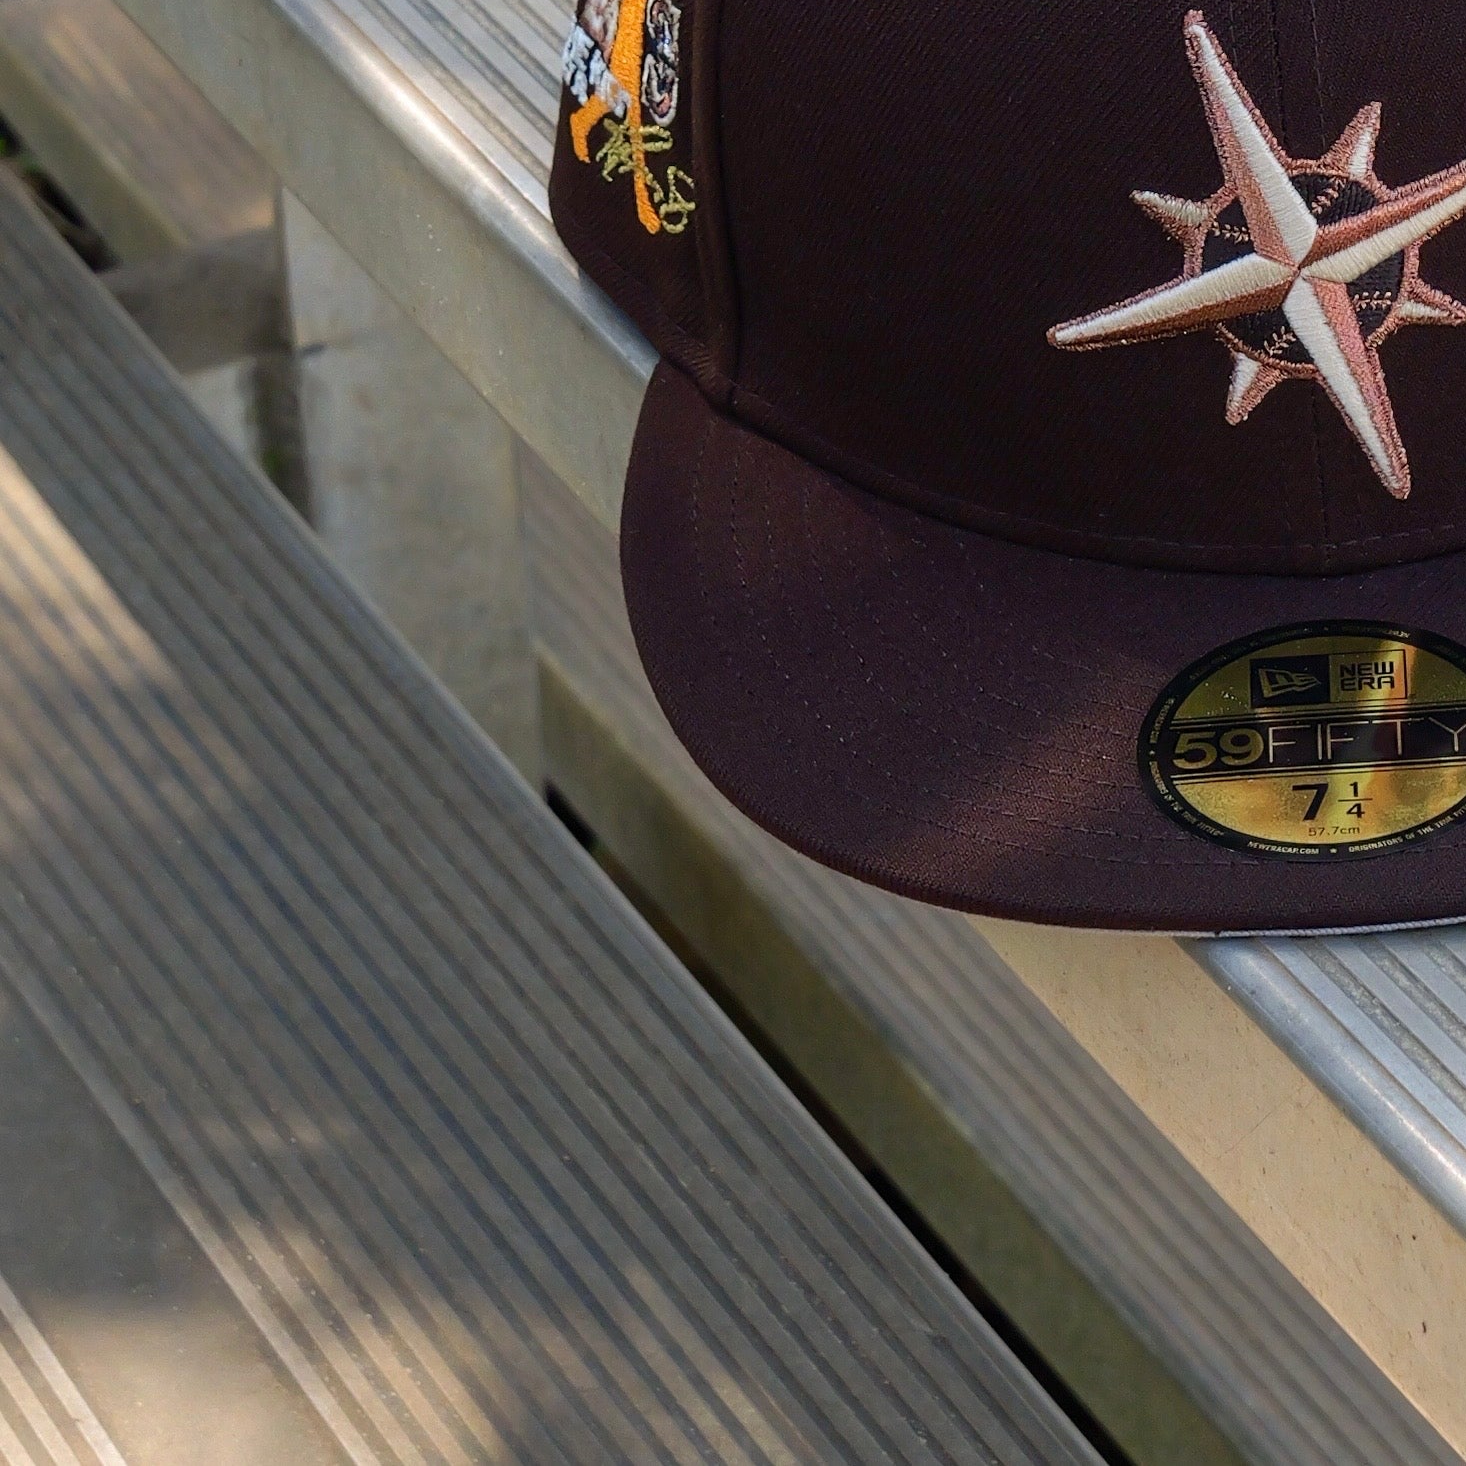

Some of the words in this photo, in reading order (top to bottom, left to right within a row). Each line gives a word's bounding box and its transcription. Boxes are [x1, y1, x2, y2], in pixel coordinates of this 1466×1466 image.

[1339, 660, 1395, 677] NEW
[1340, 676, 1395, 692] ERA
[1291, 782, 1329, 822] 7
[1308, 824, 1361, 837] 57.7cm
